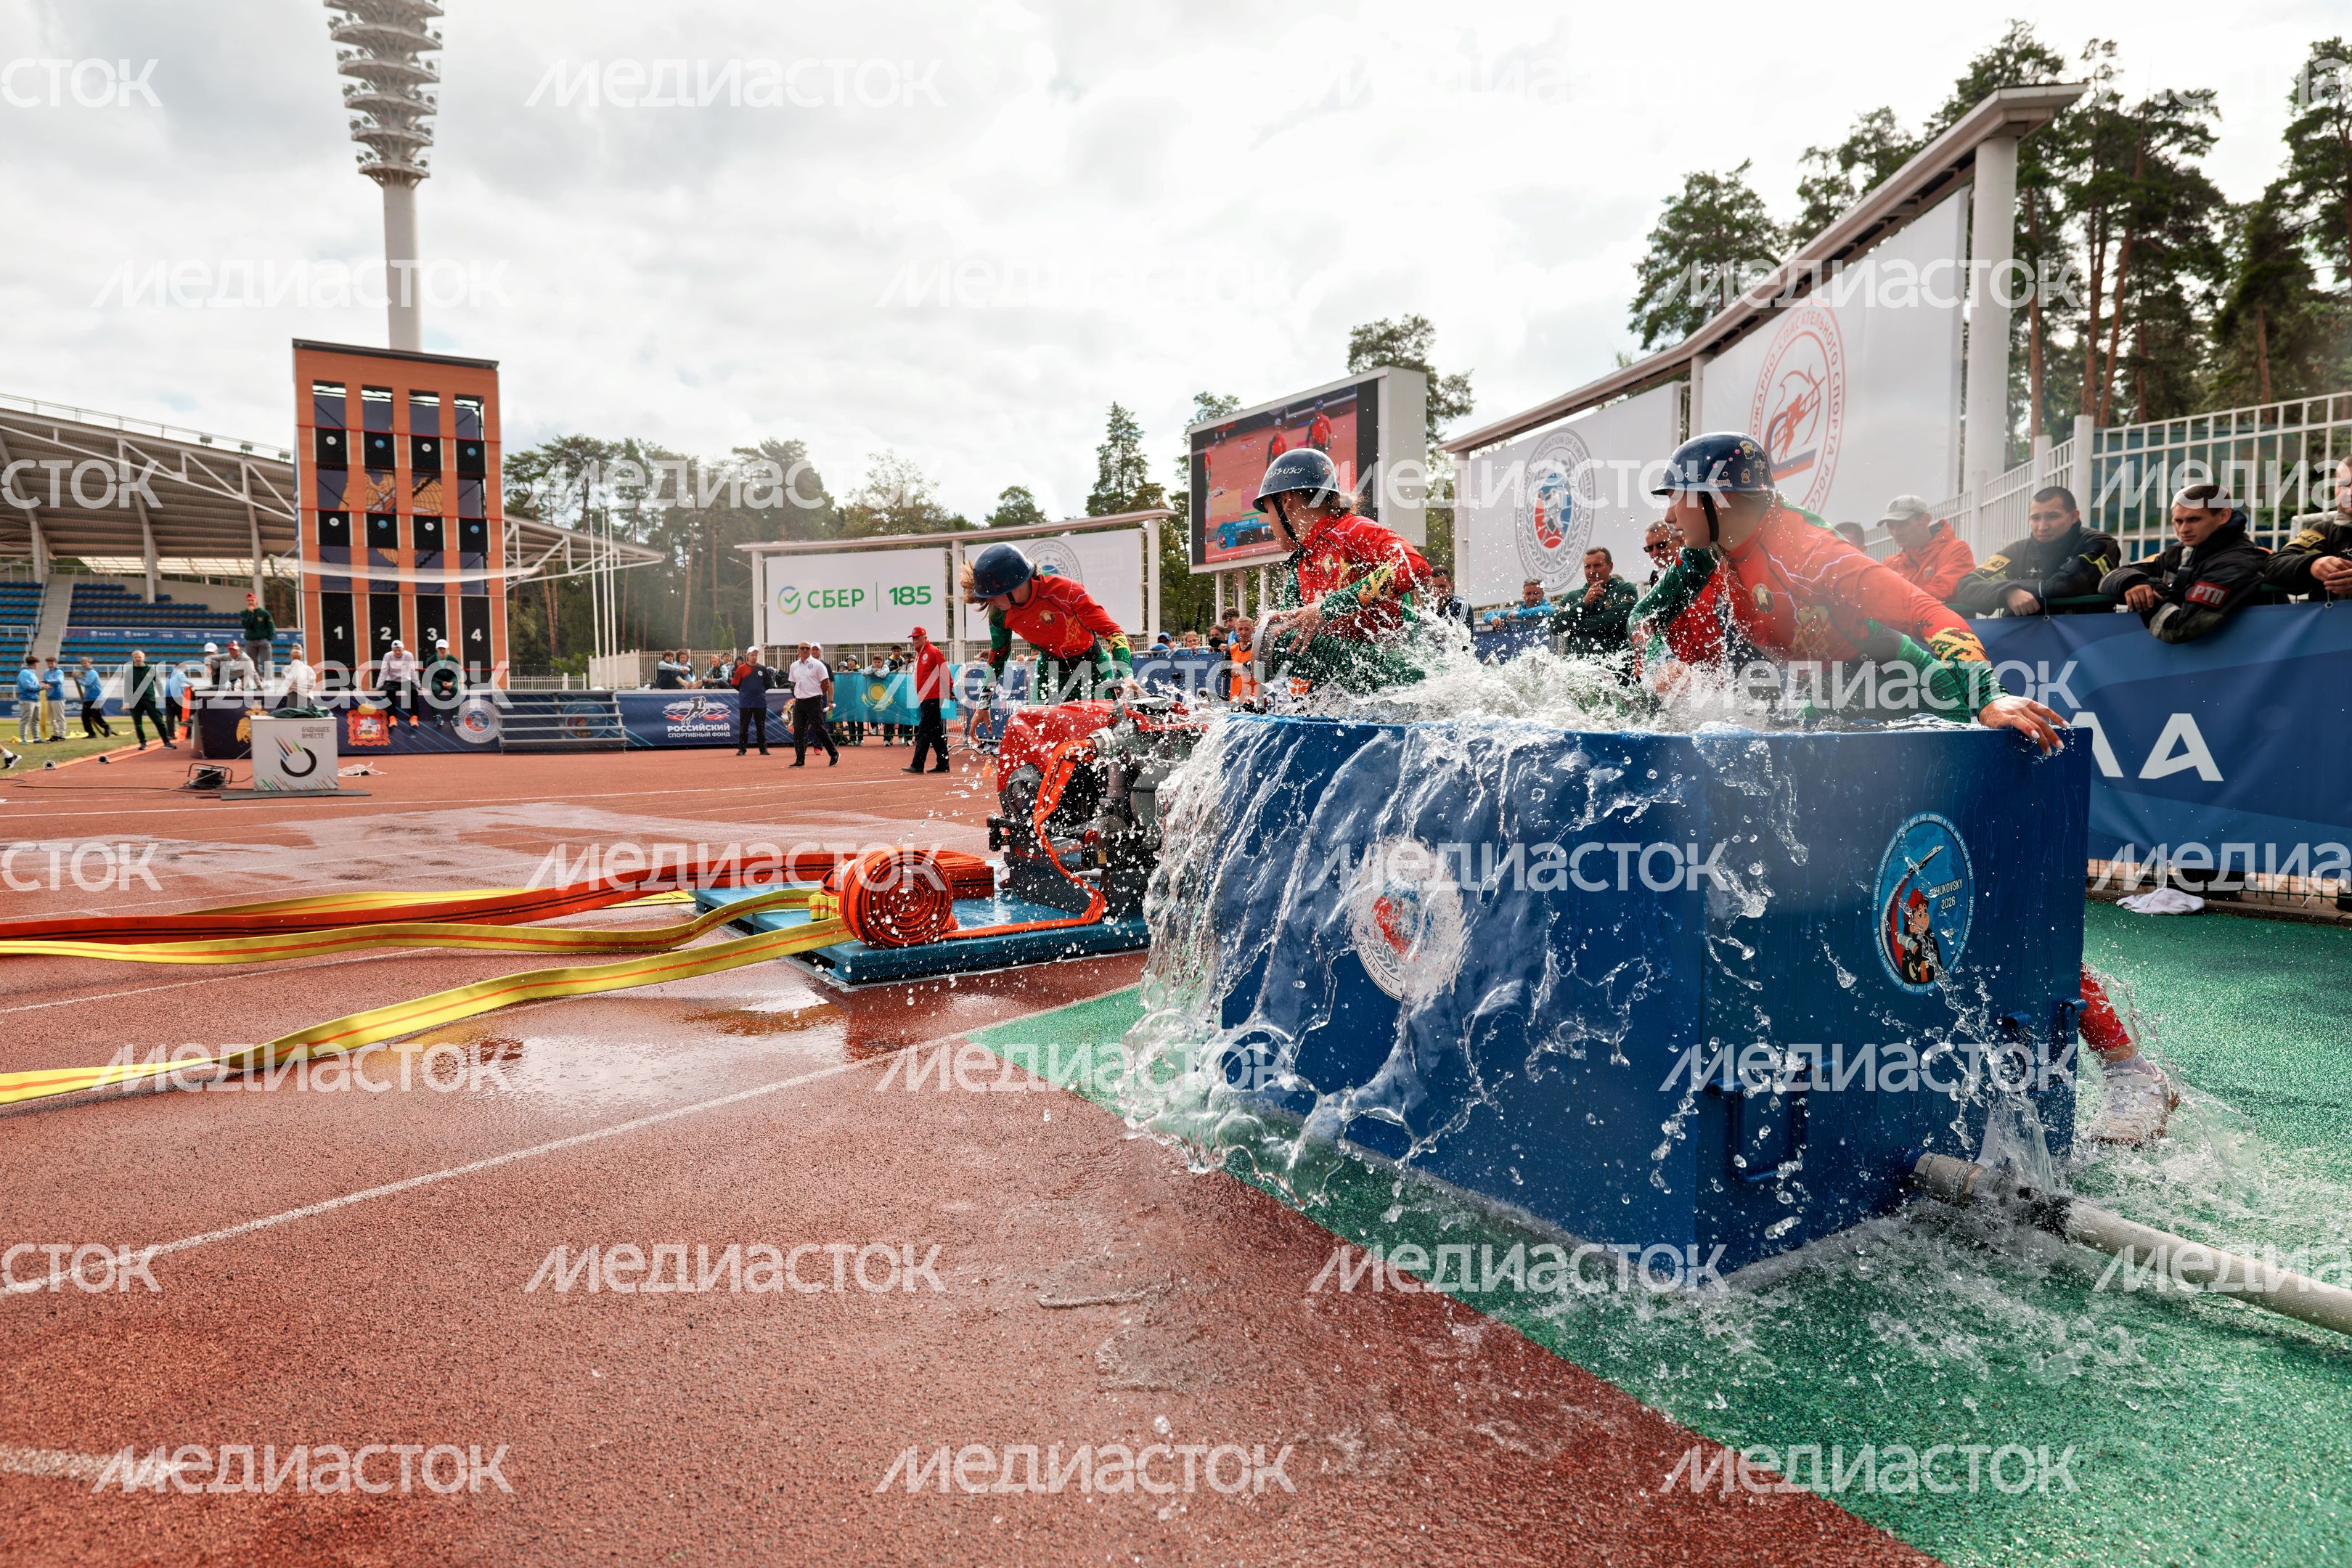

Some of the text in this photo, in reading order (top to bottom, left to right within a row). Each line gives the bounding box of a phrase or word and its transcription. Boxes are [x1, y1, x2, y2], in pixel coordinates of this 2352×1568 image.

[1753, 309, 1838, 436] ОЖАРНО-СПАСАТЕЛЬНОГО
[1826, 371, 1840, 456] СПОРТА
[807, 585, 932, 609] СБЕР 185
[2192, 585, 2226, 605] РТП
[334, 626, 343, 640] 1
[380, 627, 391, 640] 2
[427, 627, 438, 641] 3
[471, 629, 482, 642] 4
[667, 722, 730, 732] РОССИЙСКИЙ
[1932, 878, 1963, 897] HUKOVSKY
[1941, 896, 1956, 910] 2026
[1964, 917, 1972, 942] RESCUE
[1874, 936, 1884, 957] WORLD
[1379, 973, 1394, 989] THE
